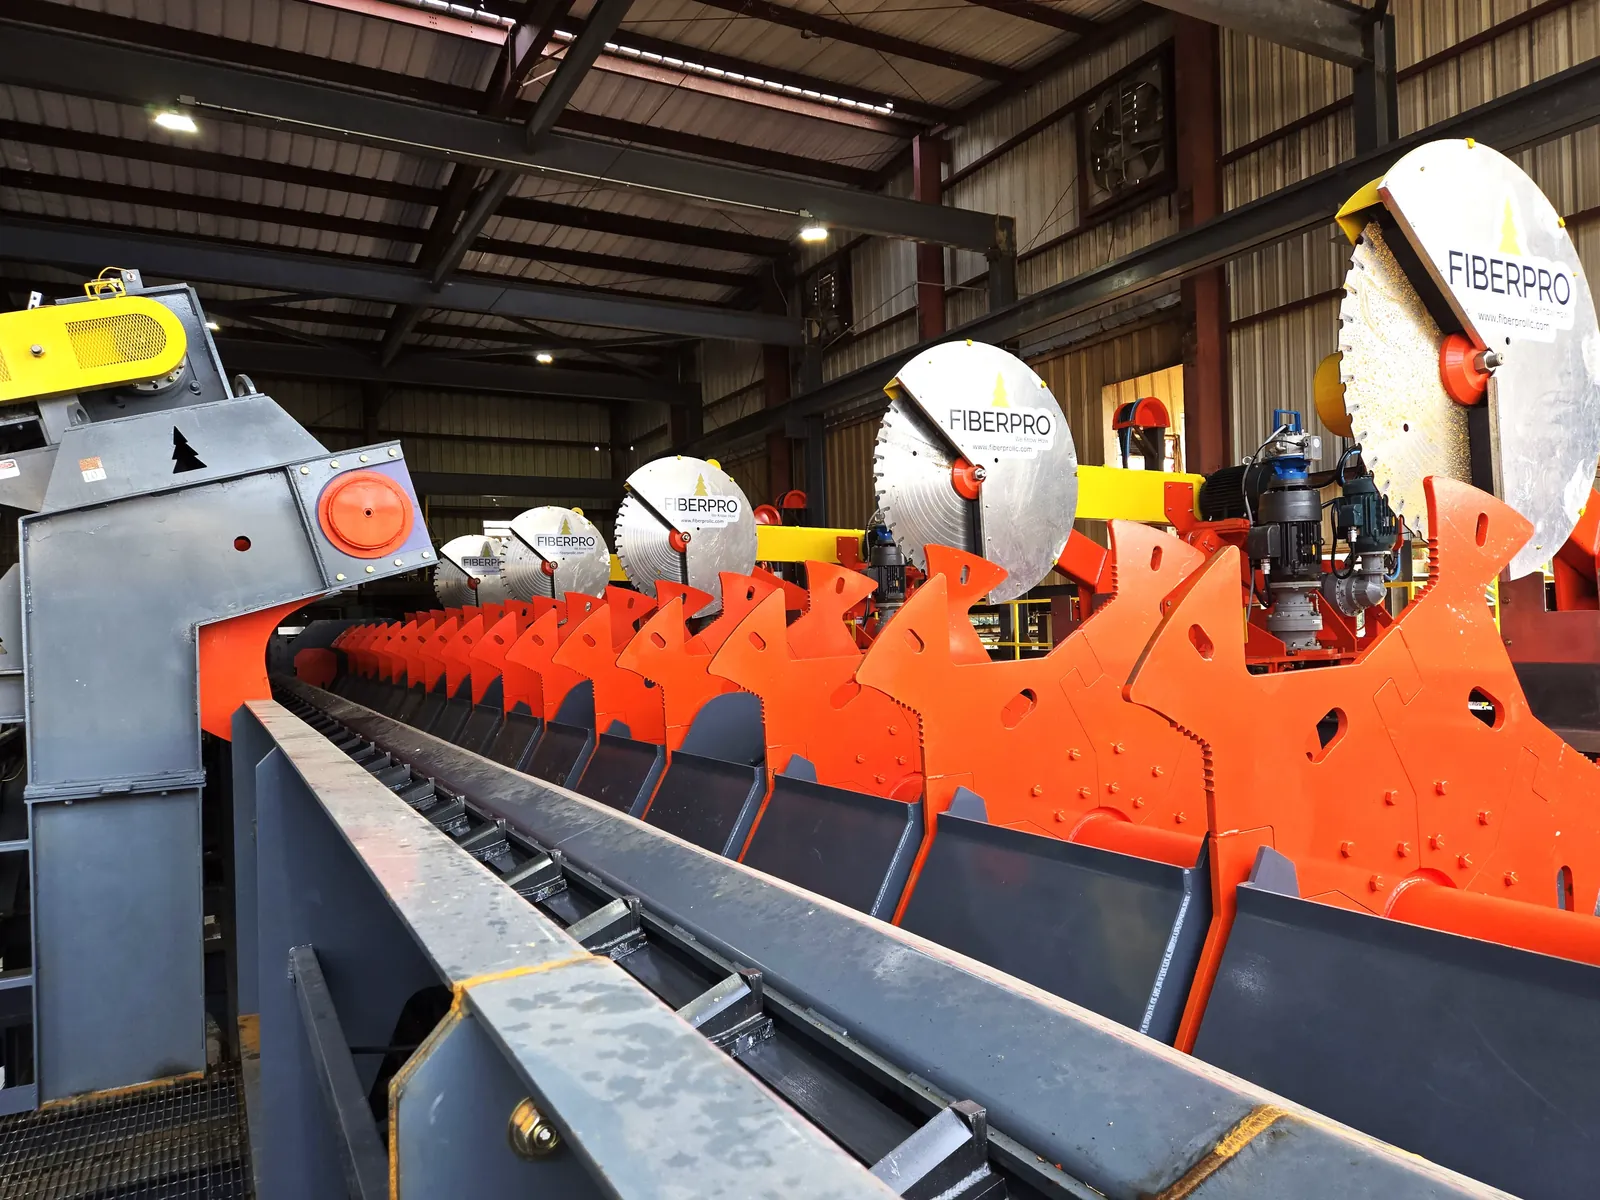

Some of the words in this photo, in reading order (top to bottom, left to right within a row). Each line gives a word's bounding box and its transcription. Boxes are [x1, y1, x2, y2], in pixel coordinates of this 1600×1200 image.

[1448, 249, 1570, 305] FIBERPRO
[1477, 312, 1550, 331] www.fiberprollc.com
[949, 409, 1051, 436] FIBERPRO
[972, 443, 1033, 453] www.fiberprollc.com
[664, 497, 738, 513] FIBERPRO
[537, 536, 596, 547] FIBERPRO
